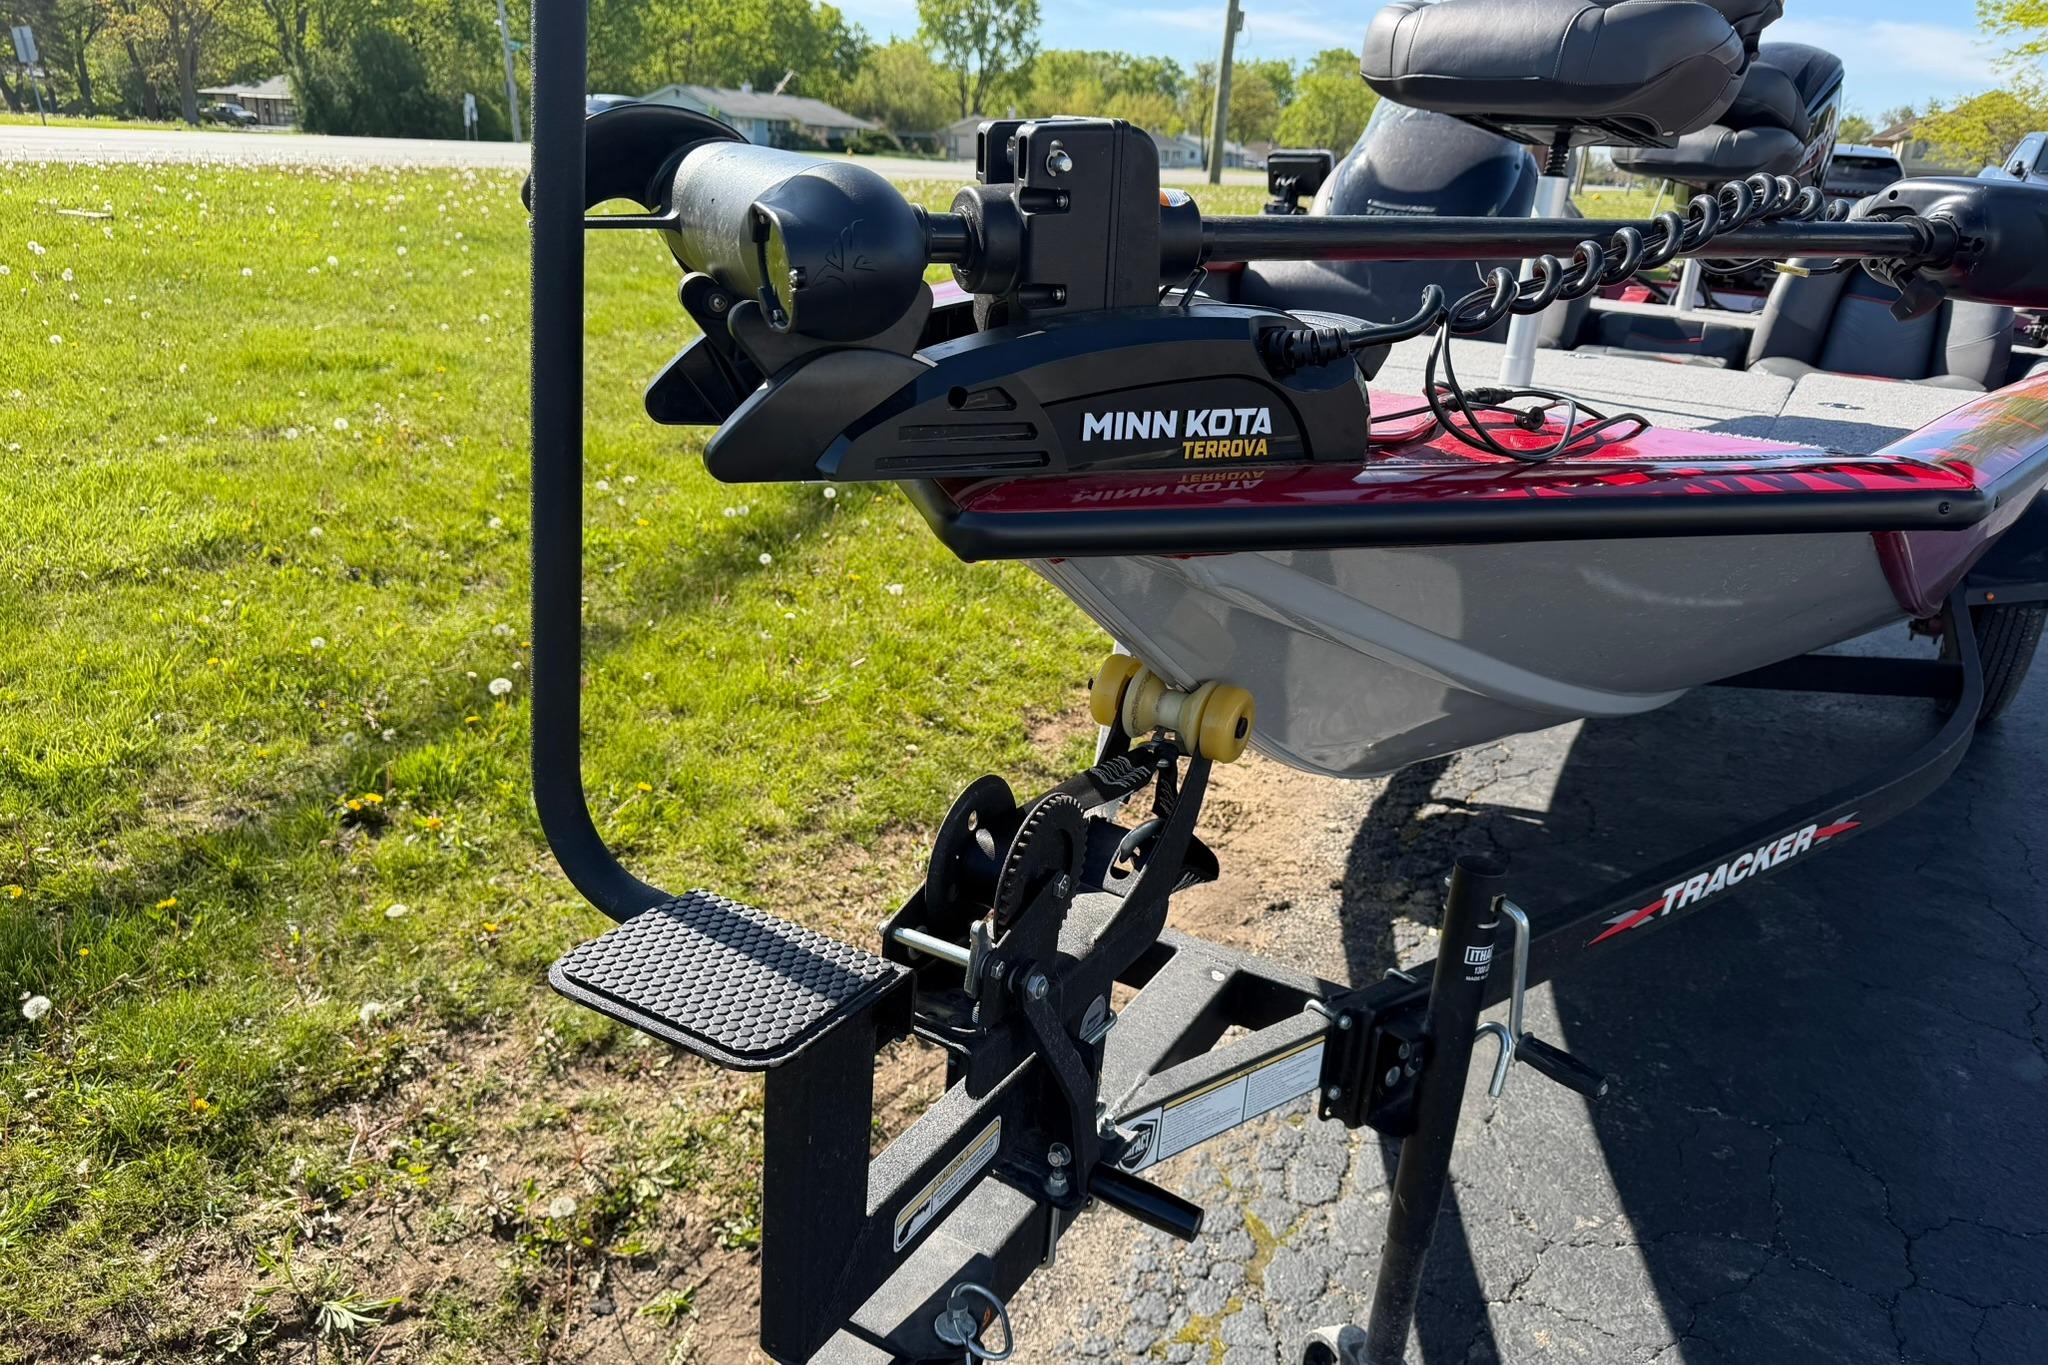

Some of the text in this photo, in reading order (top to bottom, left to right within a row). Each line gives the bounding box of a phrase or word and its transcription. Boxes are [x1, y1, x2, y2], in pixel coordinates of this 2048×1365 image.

[1082, 407, 1272, 441] MINN KOTA
[1183, 438, 1268, 460] TERROVA
[1661, 824, 1818, 916] TRACKER
